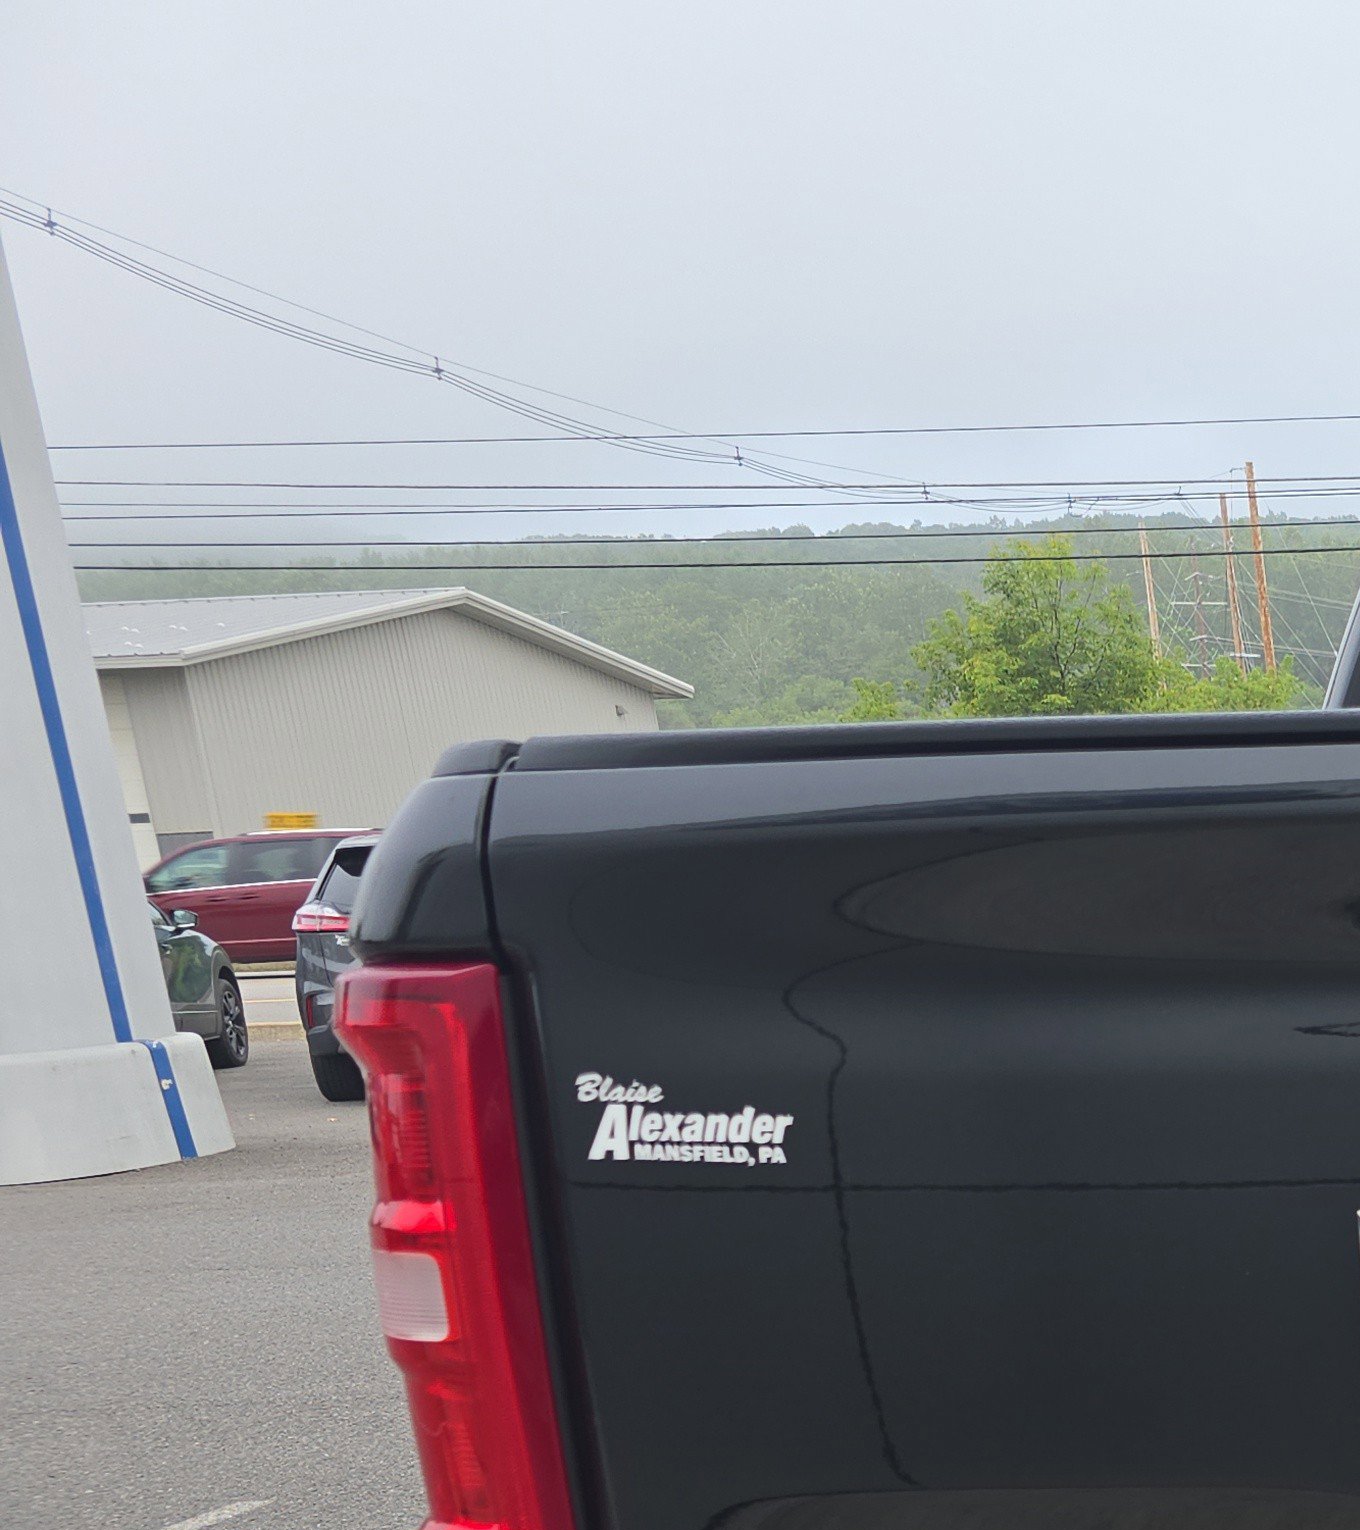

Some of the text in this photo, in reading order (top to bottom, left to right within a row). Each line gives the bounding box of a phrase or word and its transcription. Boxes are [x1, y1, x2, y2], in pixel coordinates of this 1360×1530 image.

[575, 1070, 665, 1103] Blaise
[587, 1103, 795, 1161] Alexander
[633, 1141, 787, 1167] MANSFIELD, PA
